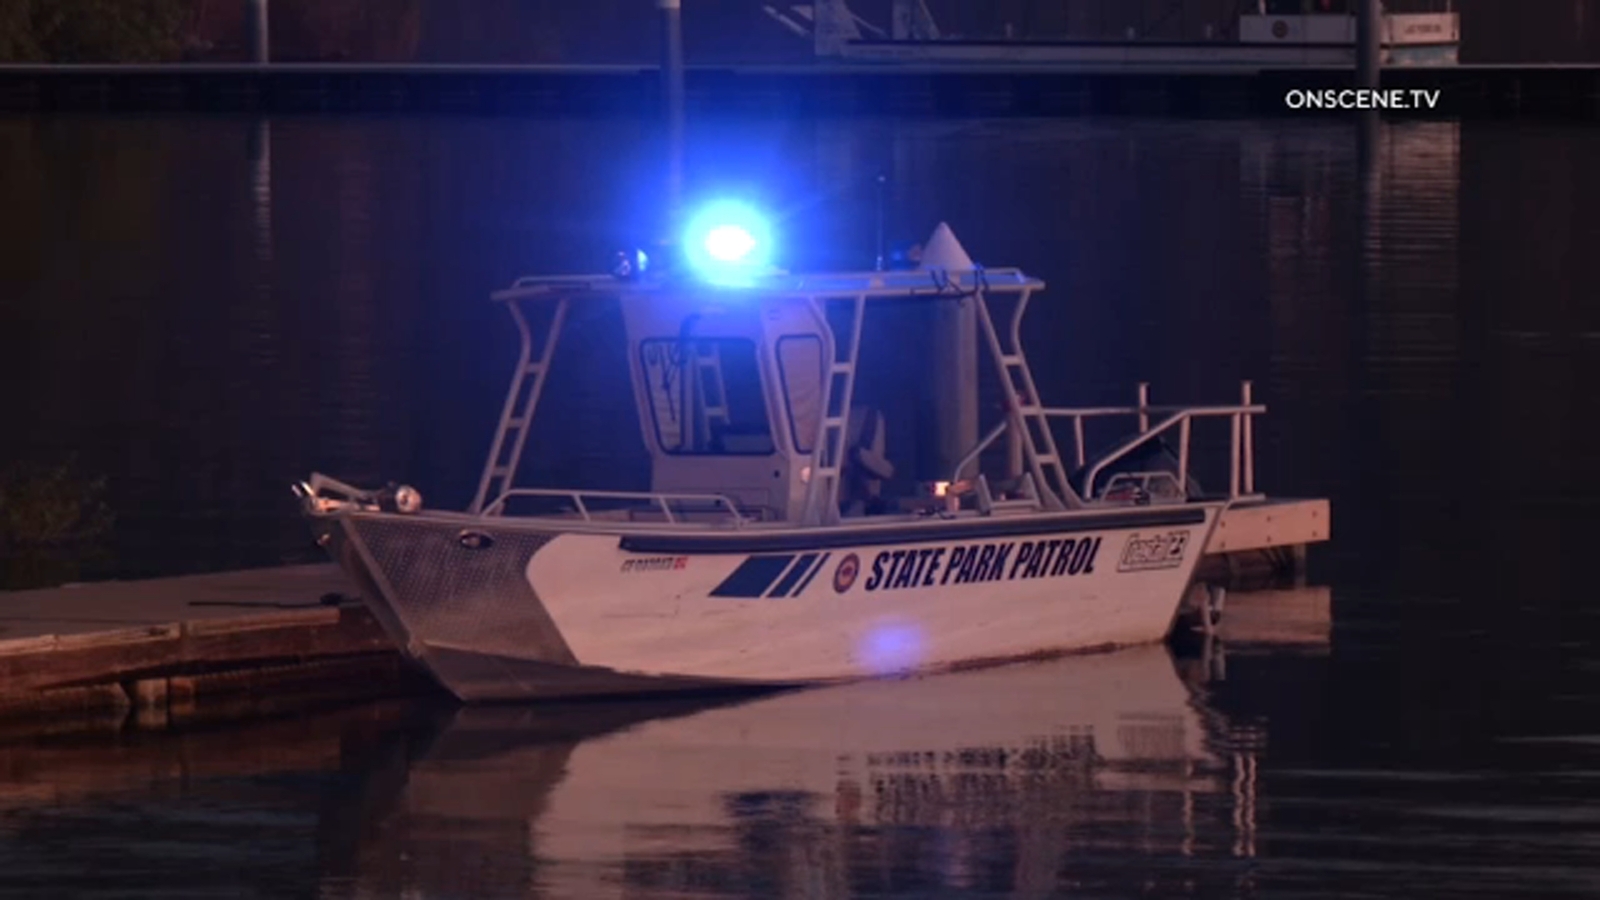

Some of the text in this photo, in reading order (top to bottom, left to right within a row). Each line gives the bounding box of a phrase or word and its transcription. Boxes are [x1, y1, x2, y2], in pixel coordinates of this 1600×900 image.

[865, 537, 1103, 591] STATE PARK PATROL
